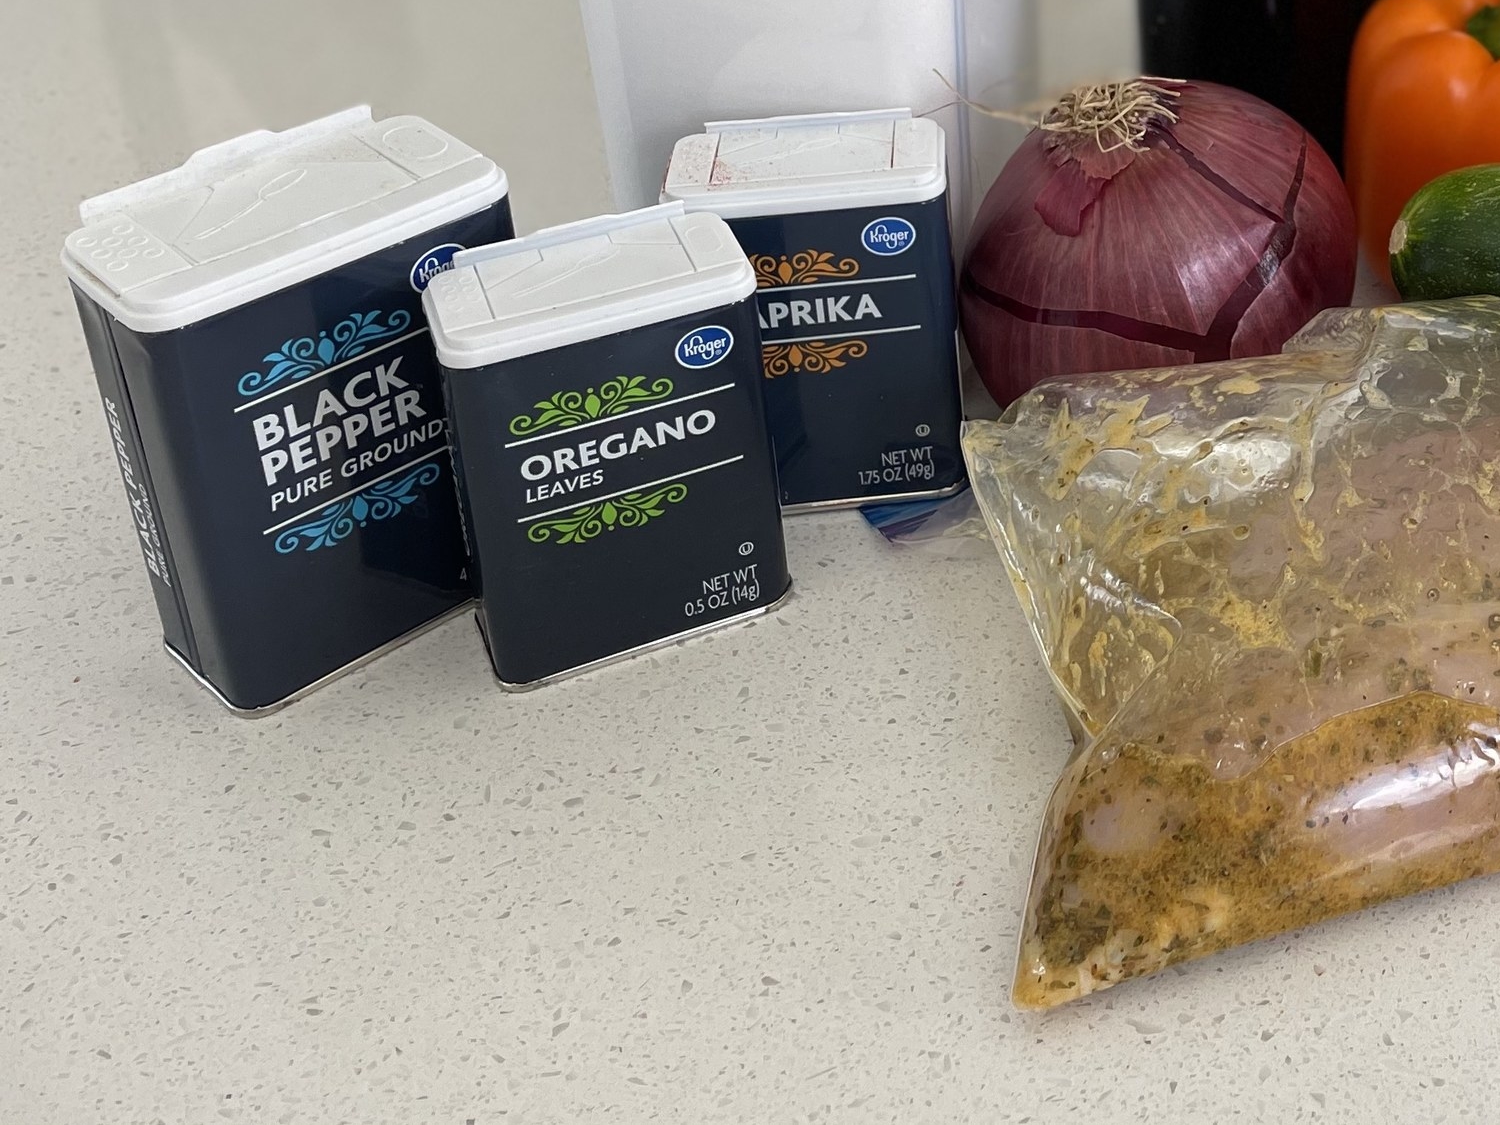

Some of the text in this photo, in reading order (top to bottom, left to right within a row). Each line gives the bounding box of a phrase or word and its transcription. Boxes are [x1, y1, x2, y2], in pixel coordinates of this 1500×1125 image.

[869, 225, 909, 249] Kroger
[419, 257, 456, 283] Kro
[683, 335, 727, 360] Kroger
[253, 355, 410, 451] BLACK
[260, 389, 427, 487] PEPPER
[520, 409, 716, 481] OREGANO
[270, 419, 444, 512] PURE GROUND
[858, 458, 935, 486] 1.75 OZ (49g)
[880, 445, 933, 467] NET WT
[105, 397, 160, 577] BLACK PEPPER
[526, 469, 604, 504] LEAVES
[702, 563, 758, 595] NET WT
[684, 578, 760, 617] 0.5 OZ (14g)
